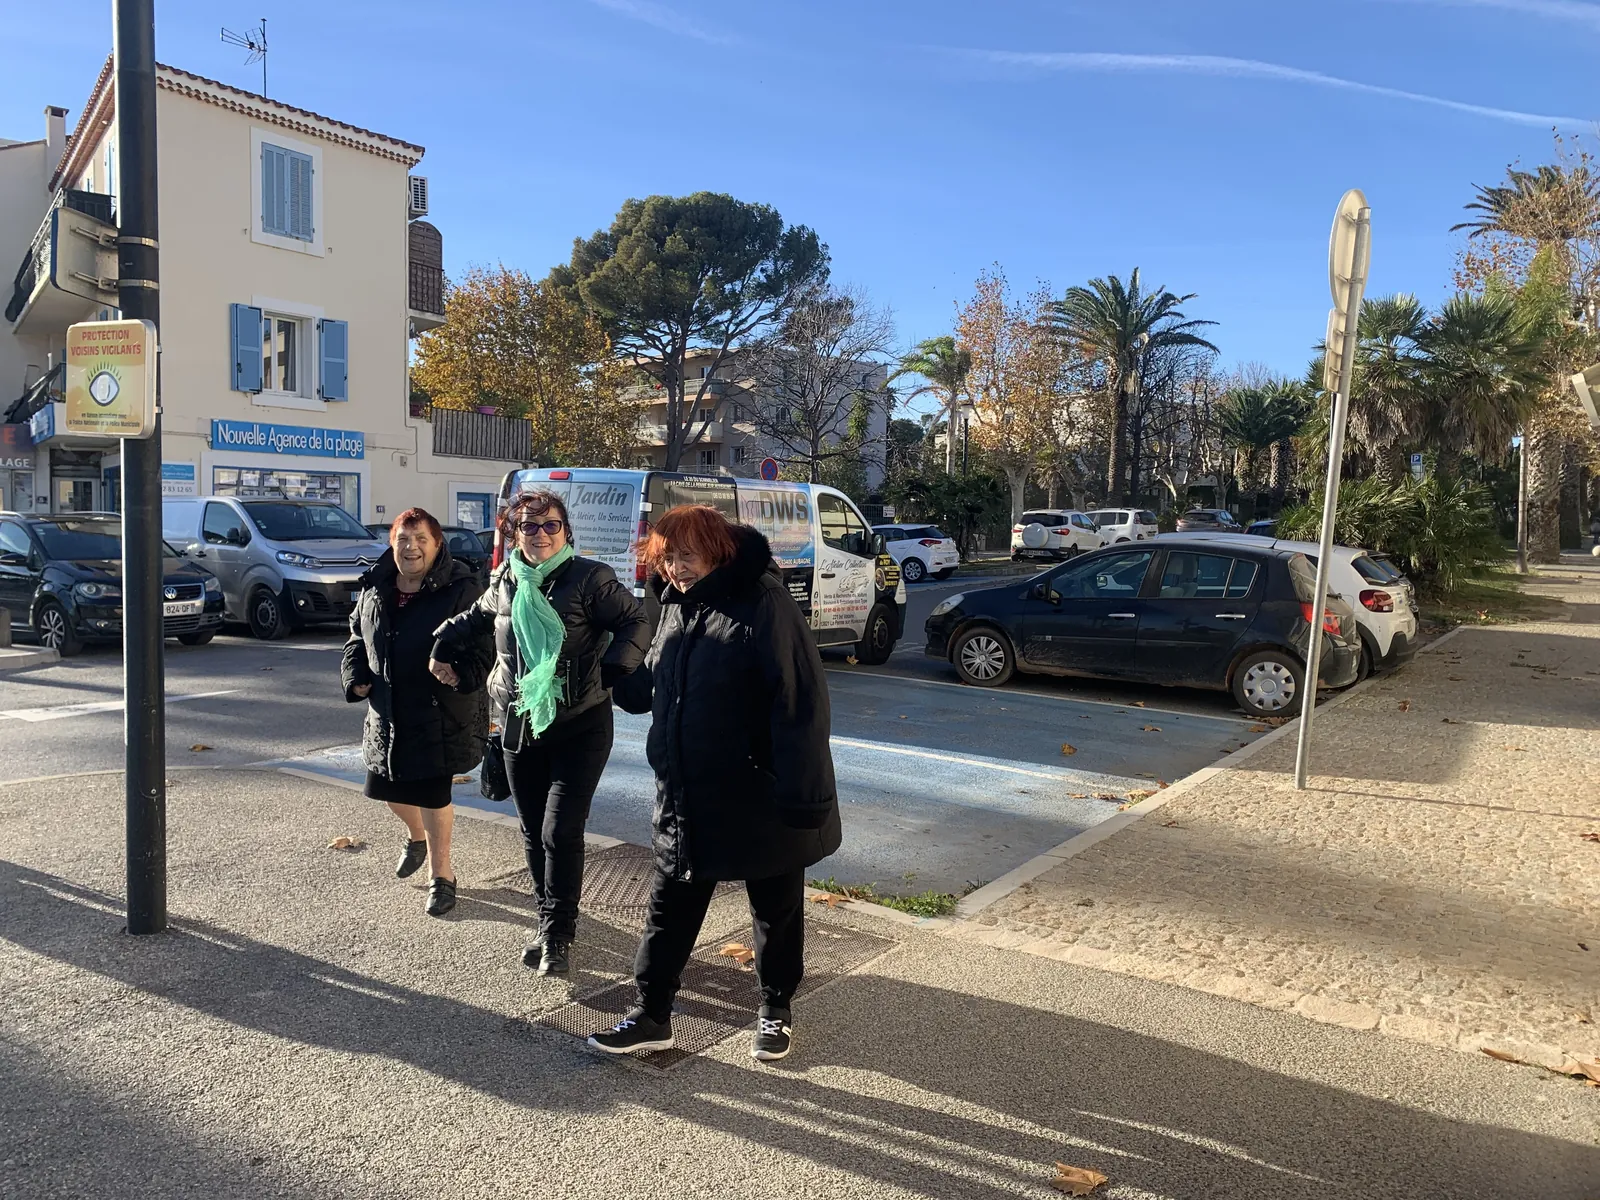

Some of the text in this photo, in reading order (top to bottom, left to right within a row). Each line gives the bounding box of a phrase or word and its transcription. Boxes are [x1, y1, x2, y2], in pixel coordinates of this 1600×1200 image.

[82, 330, 129, 340] PROTECTION
[71, 344, 141, 356] VOISINS VIGILANTS
[218, 422, 363, 457] Nouvelle Agence de la plage
[0, 458, 30, 468] LAGE
[572, 485, 627, 508] Jardin
[759, 492, 808, 524] DWS
[598, 512, 606, 520] Un
